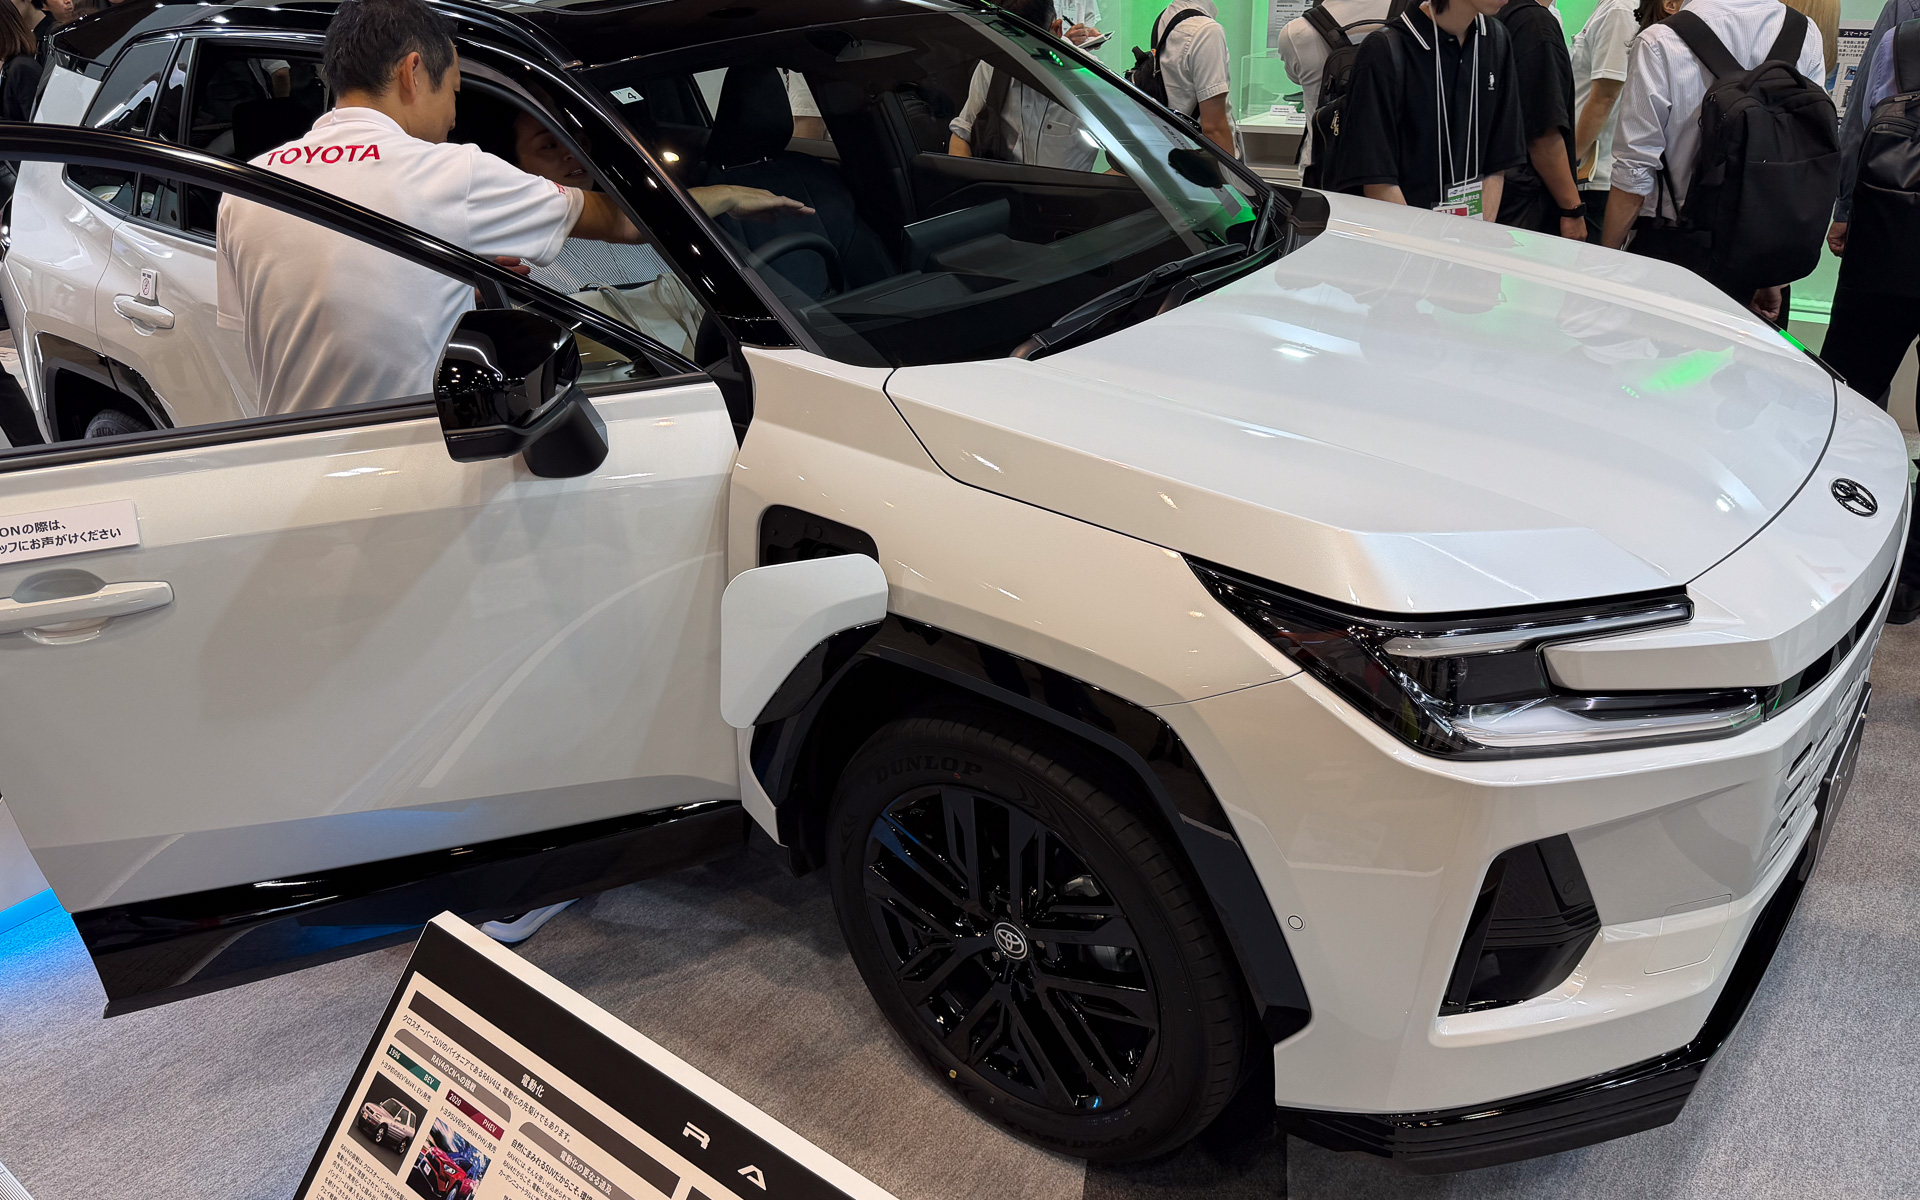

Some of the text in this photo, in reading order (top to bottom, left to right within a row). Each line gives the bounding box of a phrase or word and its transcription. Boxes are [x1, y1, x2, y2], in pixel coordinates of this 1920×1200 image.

[628, 92, 637, 100] 4
[267, 144, 381, 166] TOYOTA
[0, 519, 67, 538] ONの際は、
[0, 527, 122, 555] ッフにお声がけください
[875, 755, 983, 785] DUNLOP
[422, 1072, 435, 1086] BEV
[430, 1053, 477, 1093] RAV4のCNへの挑戦
[519, 1072, 546, 1098] 電動化
[447, 1092, 497, 1134] 2020 PHEV
